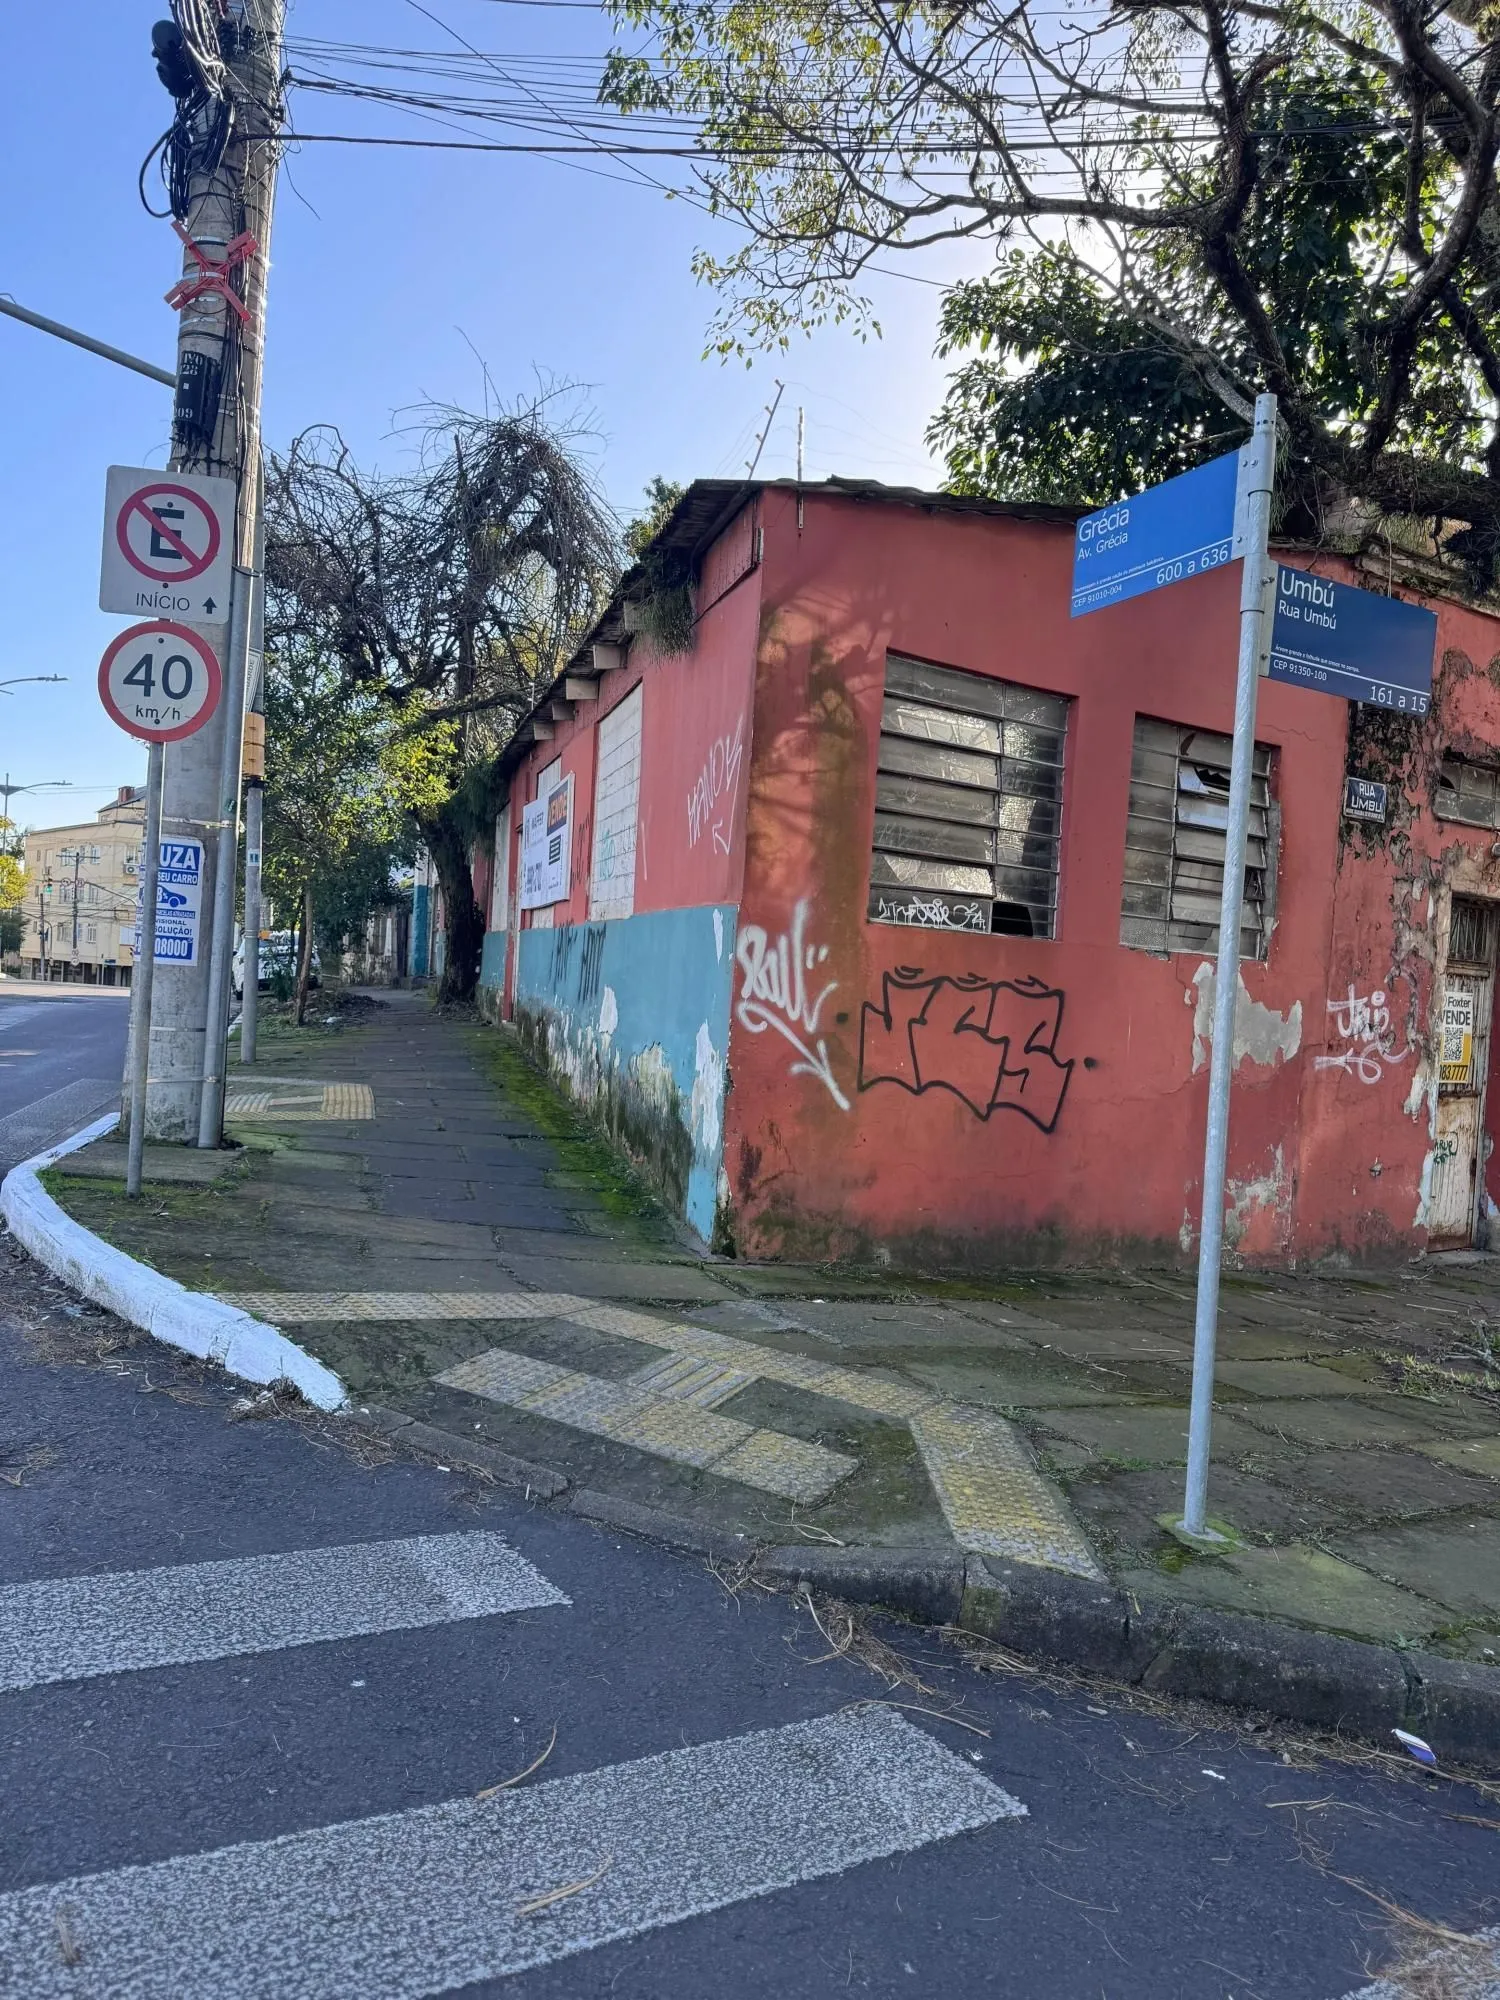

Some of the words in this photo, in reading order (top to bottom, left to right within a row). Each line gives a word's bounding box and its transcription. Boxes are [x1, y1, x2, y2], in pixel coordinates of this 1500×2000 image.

[149, 507, 185, 560] E
[1078, 508, 1130, 542] Grécia
[1077, 547, 1092, 562] Av.
[1096, 531, 1128, 554] Grécia
[1156, 562, 1182, 585] 600
[1187, 560, 1195, 574] a
[1201, 544, 1228, 568] 636
[136, 591, 190, 611] INÍCIO
[1073, 597, 1087, 608] CEP
[1087, 584, 1122, 605] 91010-004
[1281, 570, 1335, 608] Umbú
[1279, 600, 1300, 619] Rua
[1304, 609, 1337, 630] Umbú
[122, 653, 193, 701] 40
[1273, 659, 1288, 670] CEP
[1289, 663, 1327, 681] 91350-100
[1370, 685, 1393, 705] 161
[1398, 696, 1406, 708] a
[1411, 696, 1427, 713] 15
[136, 704, 181, 721] km/h
[1359, 782, 1376, 798] RUA
[160, 845, 197, 870] UZA
[171, 872, 198, 884] CARRO
[1447, 996, 1471, 1008] Foxter
